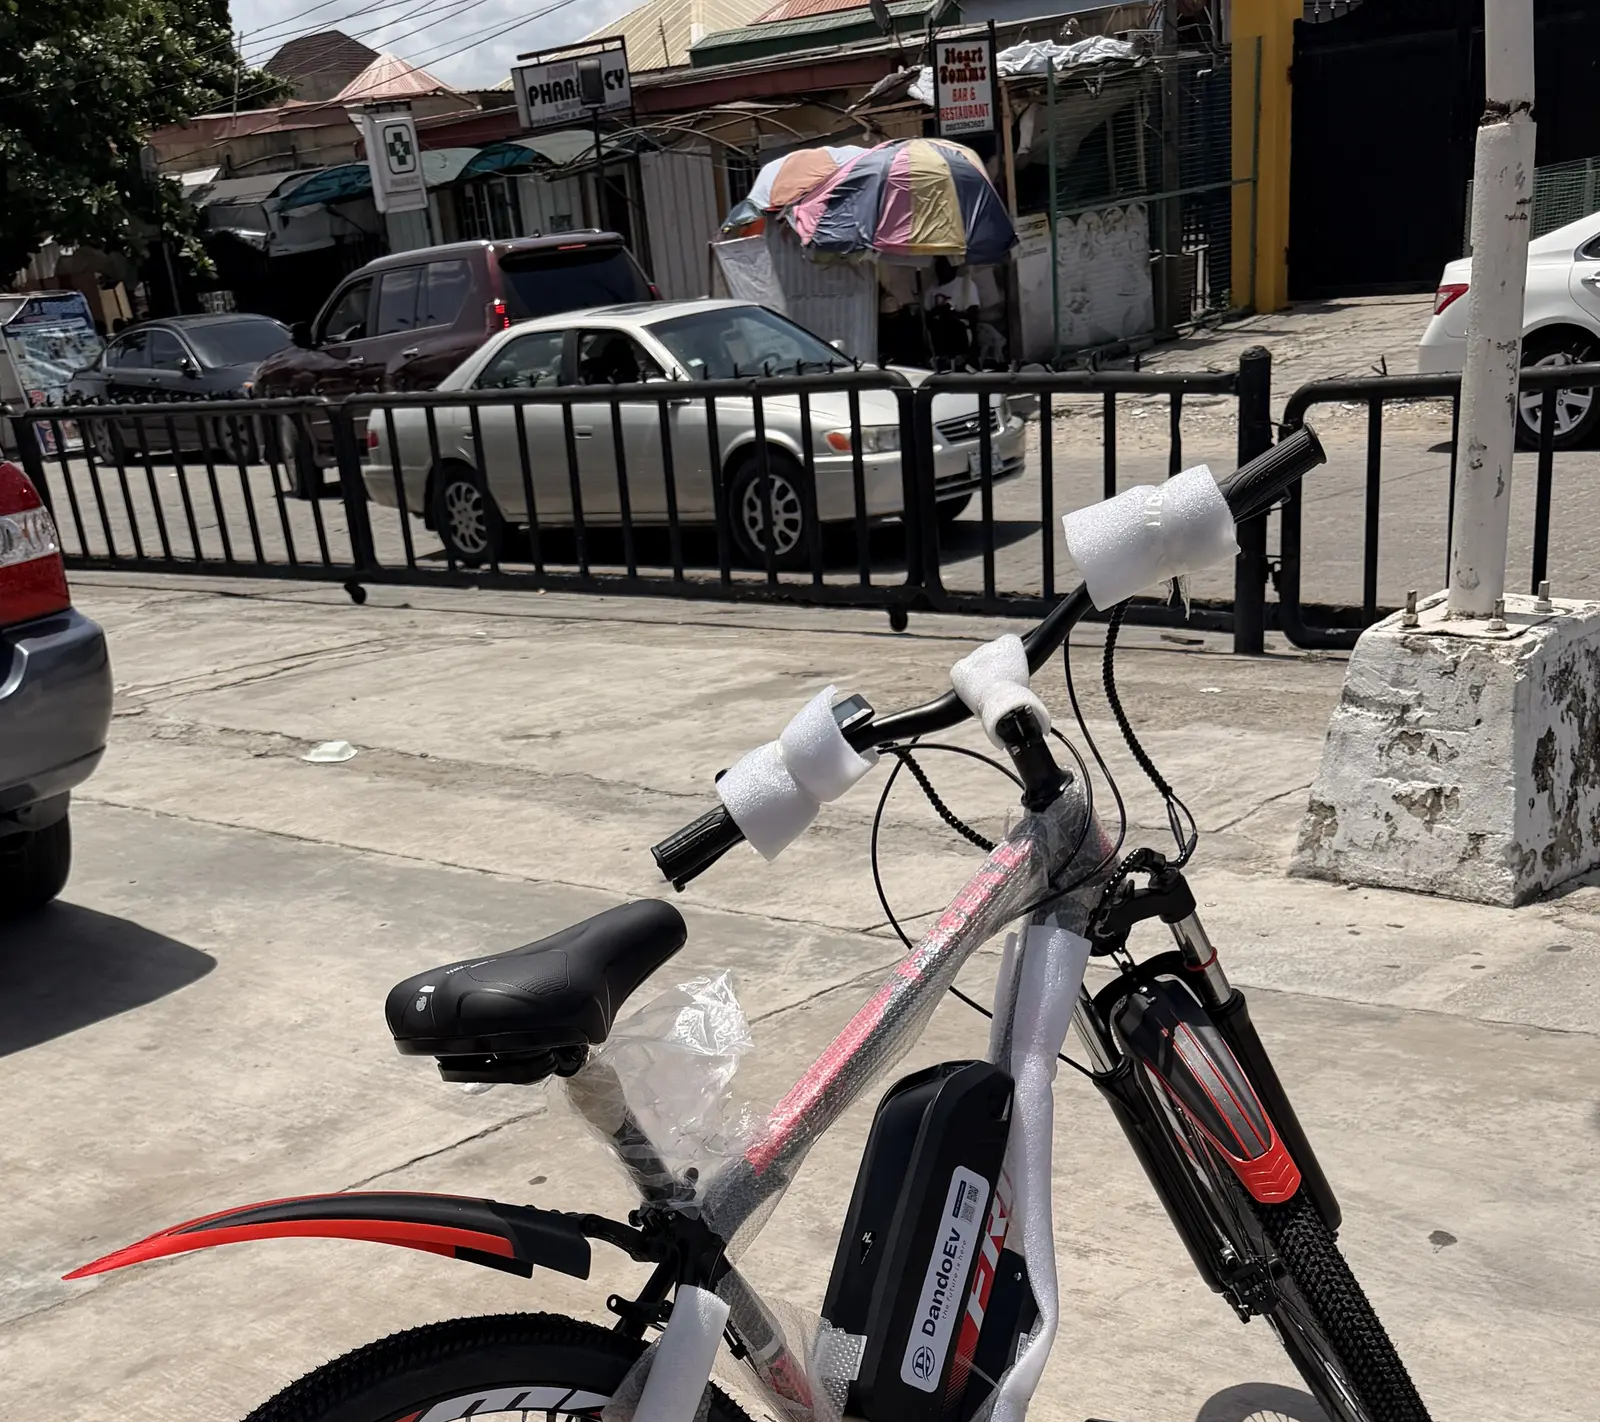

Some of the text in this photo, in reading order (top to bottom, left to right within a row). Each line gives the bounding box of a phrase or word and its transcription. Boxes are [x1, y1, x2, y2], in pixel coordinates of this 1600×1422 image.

[528, 68, 625, 107] PHARCY
[952, 88, 968, 102] BAR
[940, 103, 989, 121] RESTAURANT
[921, 1227, 961, 1337] DandoEv
[942, 1305, 950, 1319] the
[946, 1273, 959, 1304] future
[958, 1239, 967, 1260] here
